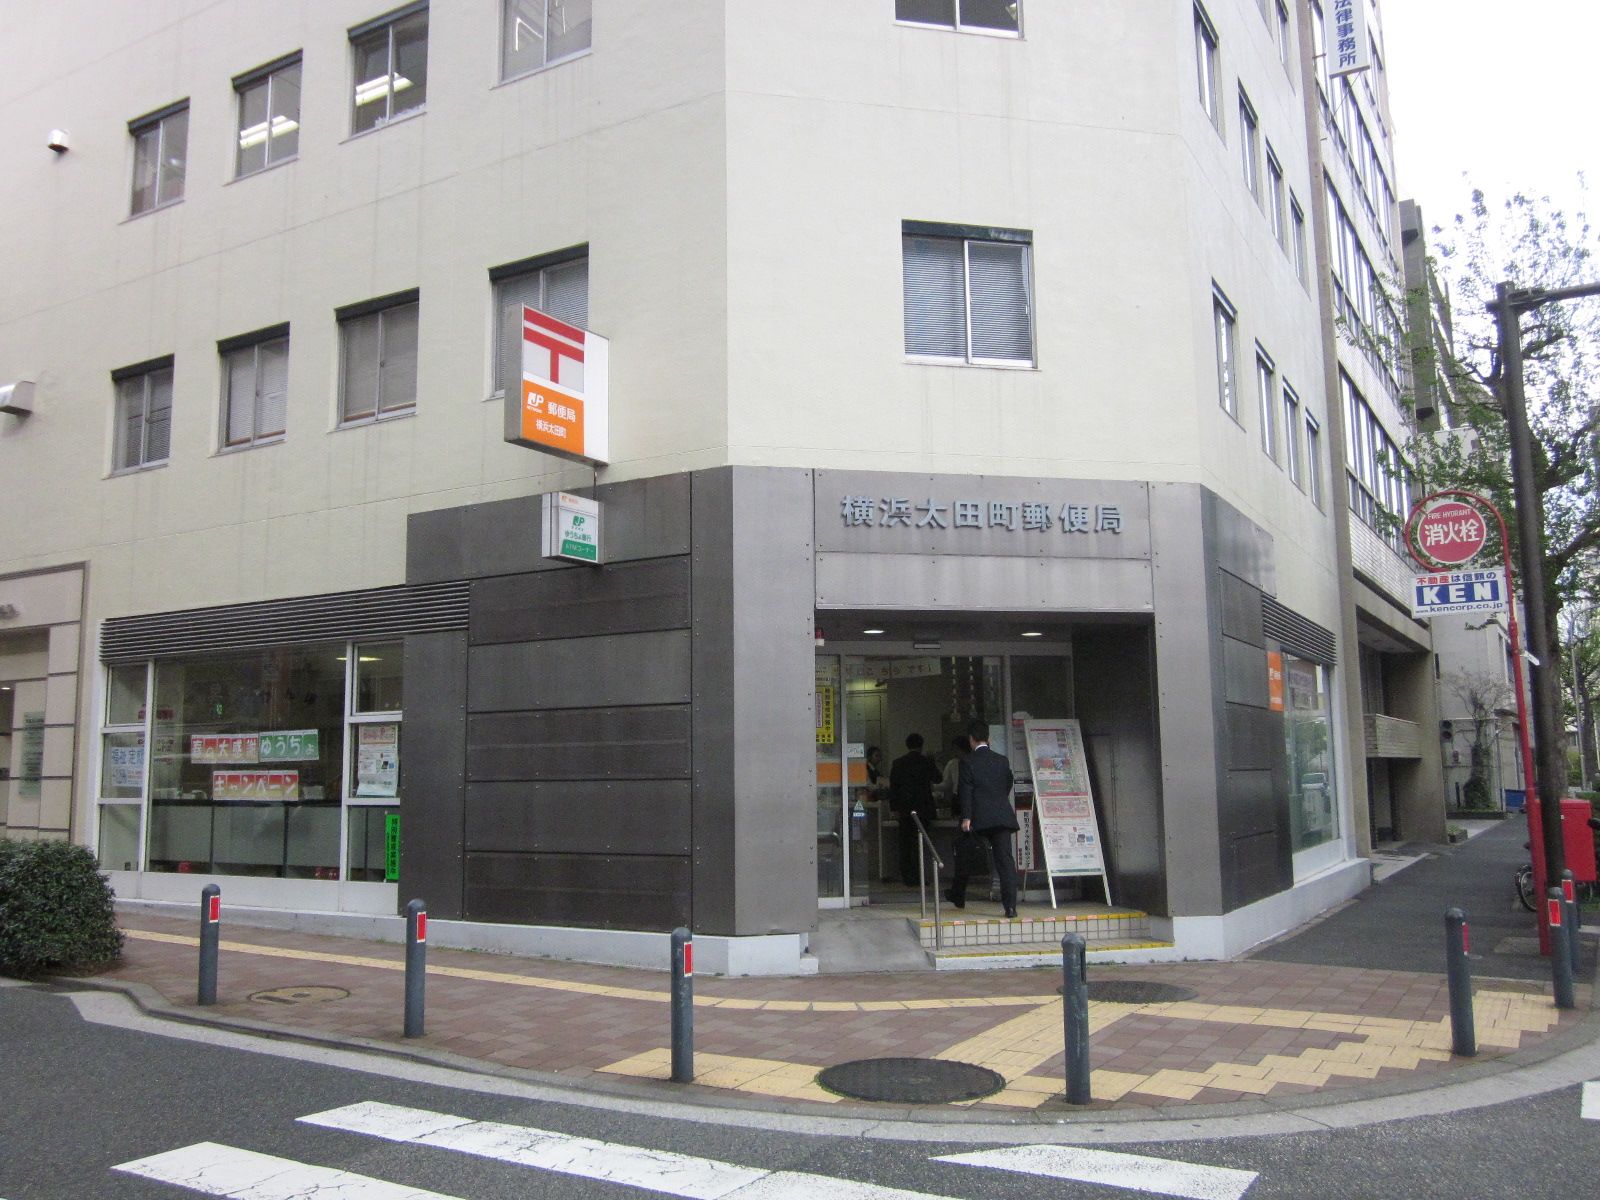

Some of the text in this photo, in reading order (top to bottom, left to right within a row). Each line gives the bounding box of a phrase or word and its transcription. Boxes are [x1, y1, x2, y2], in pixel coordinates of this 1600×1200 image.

[1334, 0, 1357, 67] 法律事務所
[547, 401, 576, 422] 郵便局
[535, 418, 567, 438] 横浜太田町
[841, 496, 1123, 533] 横浜太田町郵便局
[1427, 508, 1472, 520] FIRE HYDRANT
[564, 530, 592, 542] ゆうちょ銀行
[1424, 518, 1480, 546] 消火栓
[1416, 571, 1497, 585] 不動産は信頼の
[1422, 582, 1493, 604] KEN
[260, 735, 315, 756] ゆうちょ
[215, 775, 296, 795] キャンペーン
